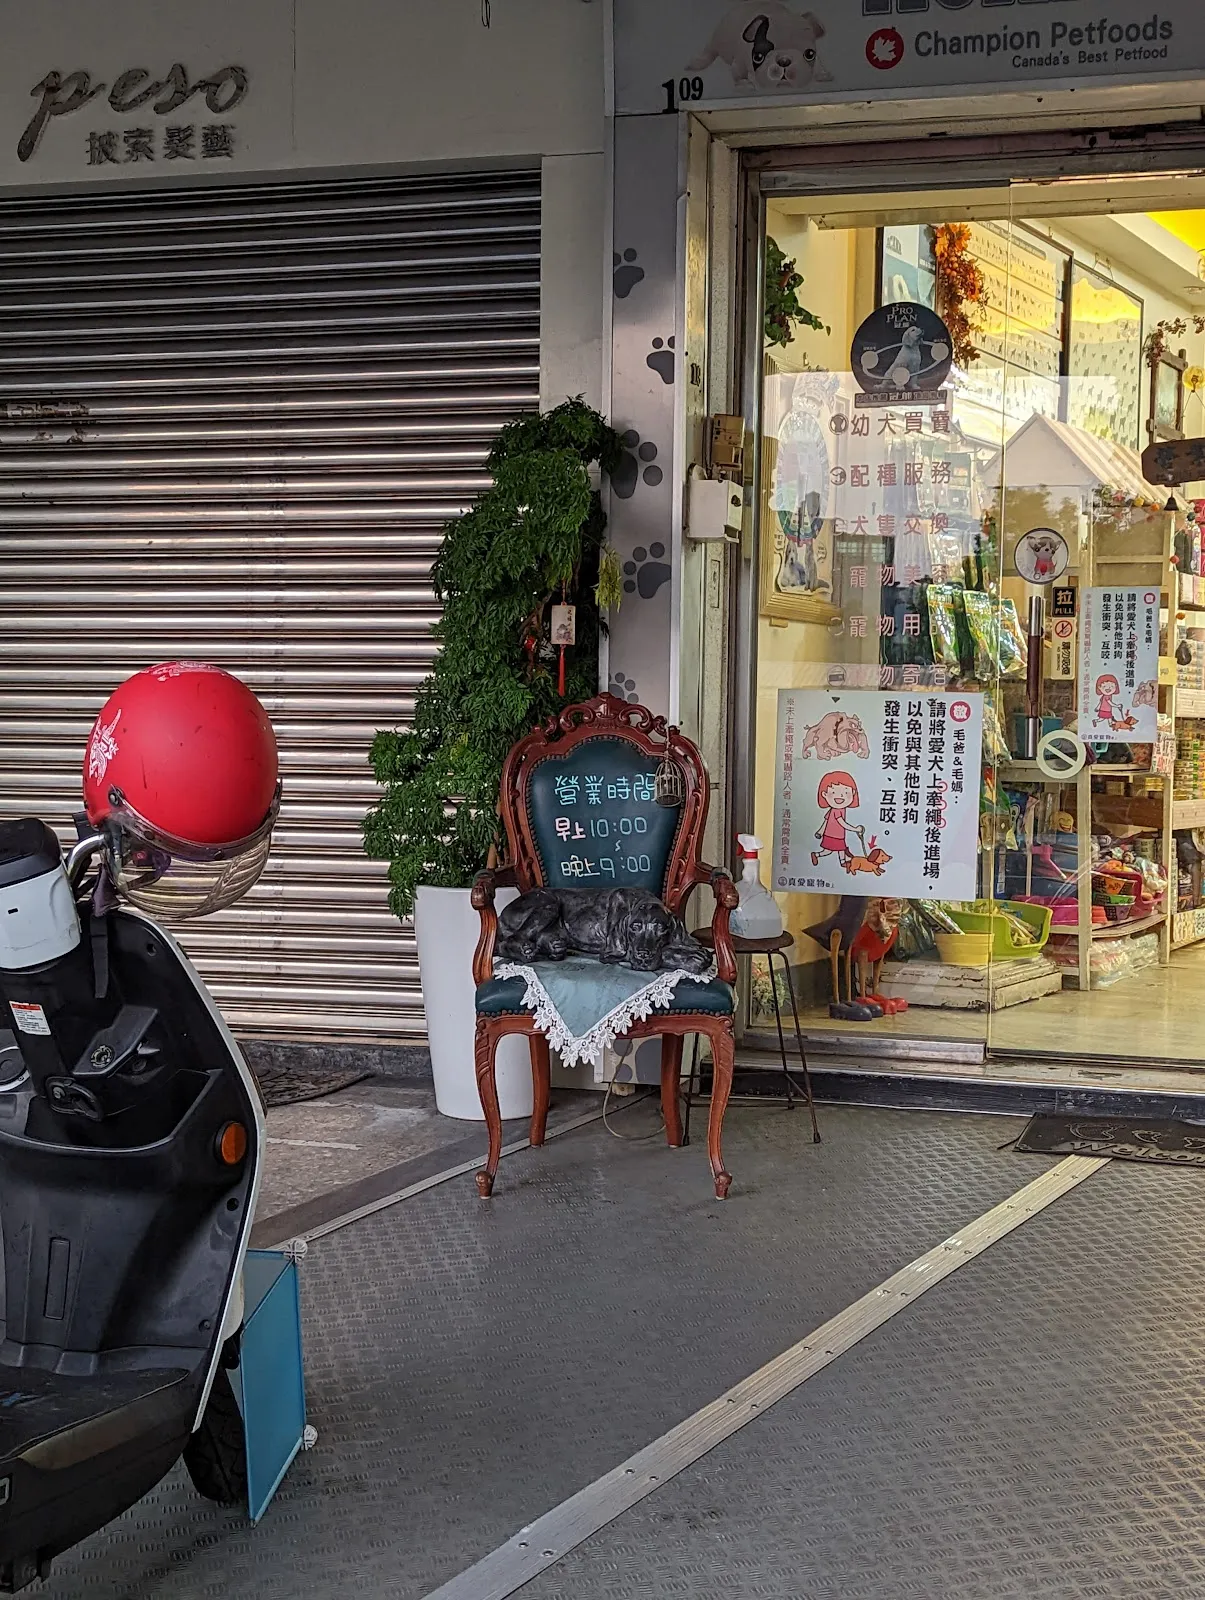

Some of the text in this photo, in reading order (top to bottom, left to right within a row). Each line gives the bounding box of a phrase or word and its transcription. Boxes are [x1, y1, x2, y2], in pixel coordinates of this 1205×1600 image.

[914, 14, 1174, 57] Champion Petfoods
[1012, 45, 1168, 69] Canada's Best Petfood
[662, 76, 704, 113] 109
[17, 62, 249, 161] peso
[886, 314, 918, 323] PLAN
[891, 305, 914, 315] PRO
[850, 410, 951, 437] 幼犬買賣
[850, 461, 952, 487] 配種服務
[850, 512, 949, 537] 犬隻交換
[1056, 589, 1073, 605] 拉
[902, 700, 923, 825] 以免與其他狗狗
[554, 773, 657, 806] 營業時間
